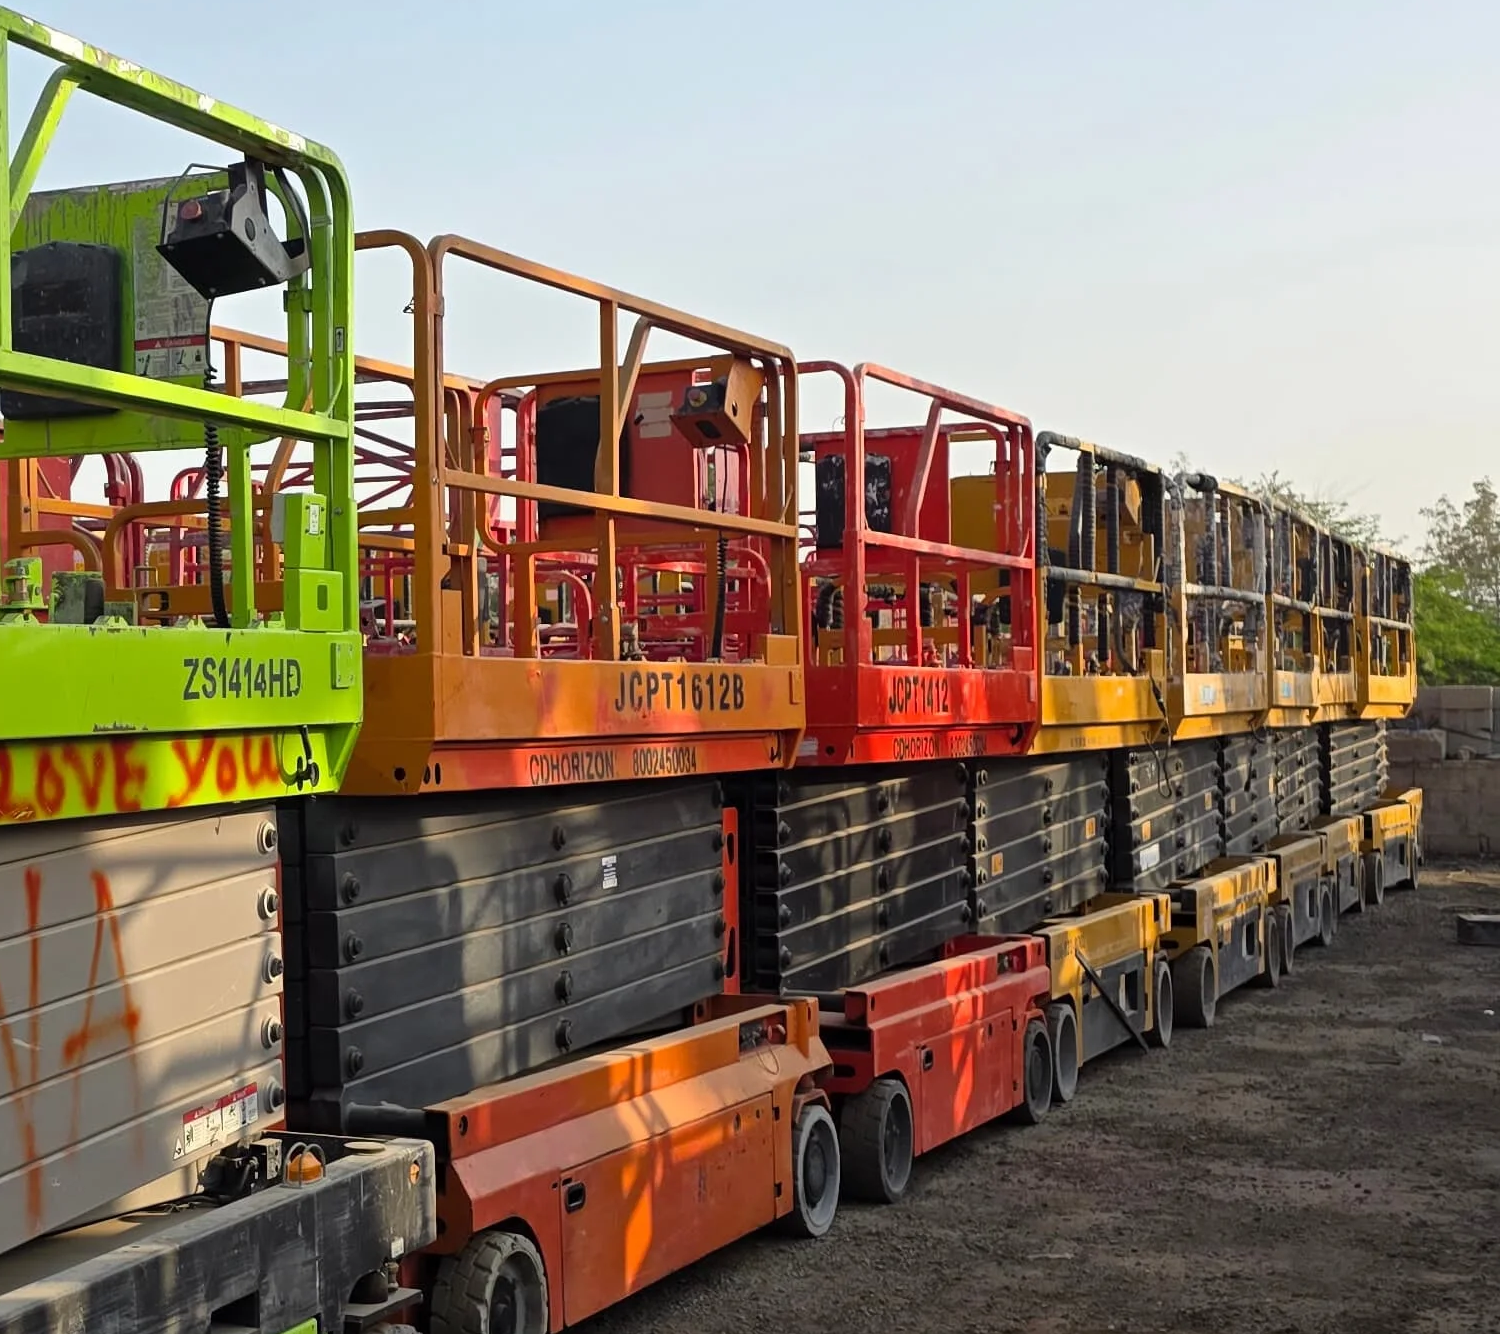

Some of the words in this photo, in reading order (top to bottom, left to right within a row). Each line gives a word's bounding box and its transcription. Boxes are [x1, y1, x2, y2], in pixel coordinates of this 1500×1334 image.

[183, 657, 301, 700] ZS1414HD
[615, 671, 744, 712] JCPT1612B
[888, 675, 949, 714] JCPT1412
[632, 746, 697, 776] 8002450034
[893, 736, 940, 760] CDHORIZON
